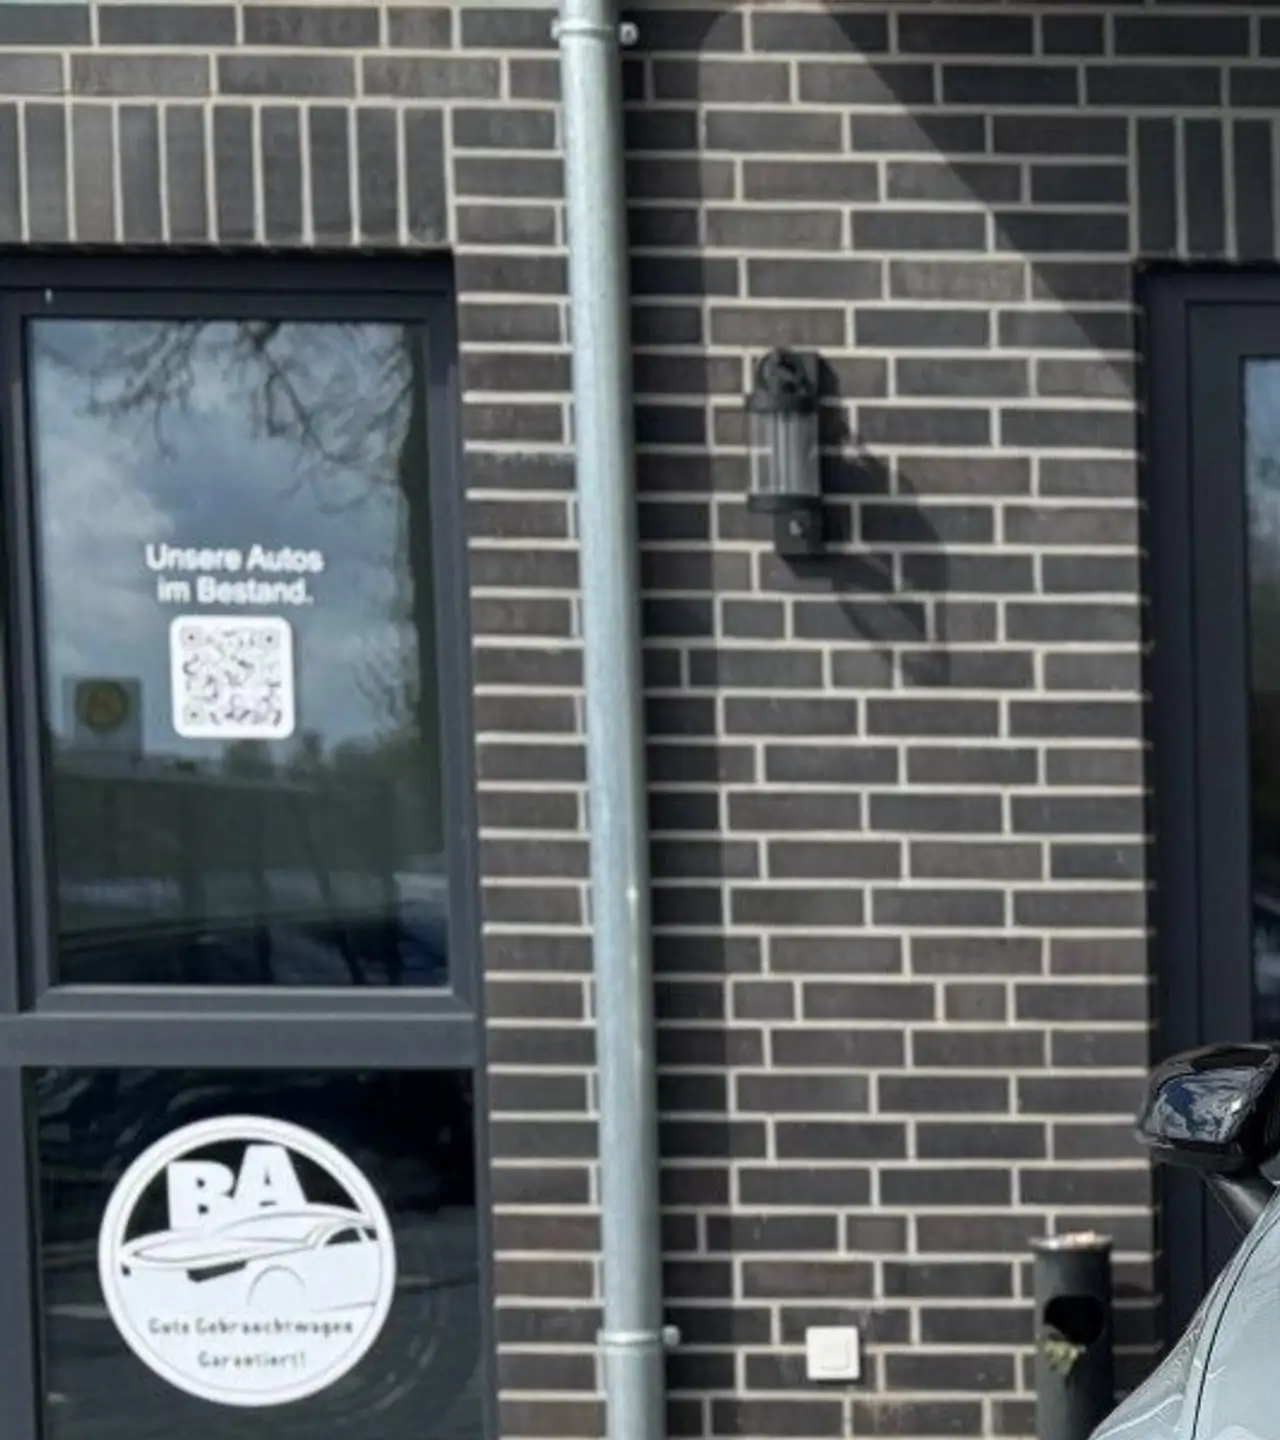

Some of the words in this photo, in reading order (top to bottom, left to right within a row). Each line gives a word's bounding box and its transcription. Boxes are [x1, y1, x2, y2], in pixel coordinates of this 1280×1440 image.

[145, 543, 242, 571] Unsere
[247, 544, 324, 572] Autos
[157, 575, 191, 604] im
[197, 576, 314, 605] Bestand.
[166, 1144, 308, 1231] BA
